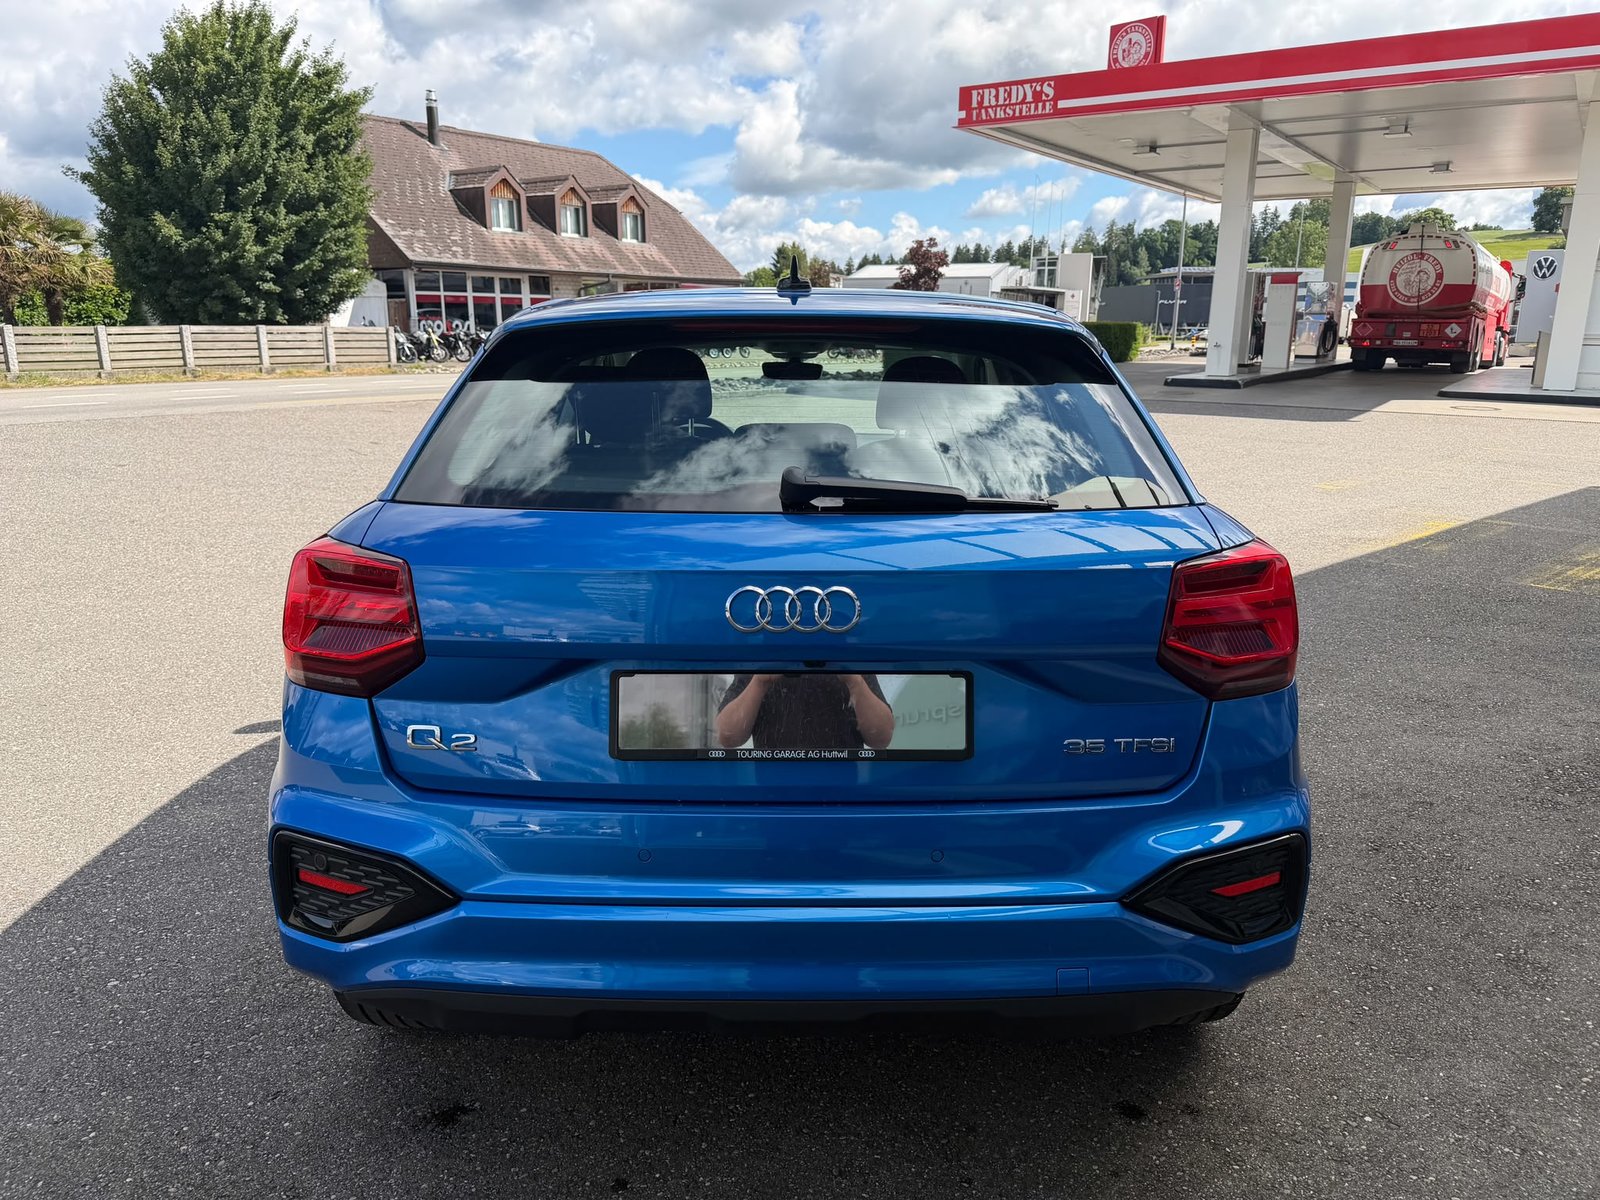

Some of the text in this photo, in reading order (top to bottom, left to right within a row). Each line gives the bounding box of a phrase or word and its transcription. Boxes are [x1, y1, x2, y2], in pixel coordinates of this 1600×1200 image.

[972, 101, 1054, 121] TANKSTELLE
[1423, 254, 1443, 274] FREDY
[736, 750, 848, 759] TOURING GARAGE AG Huttwil
[1063, 737, 1176, 754] 35 TFSI
